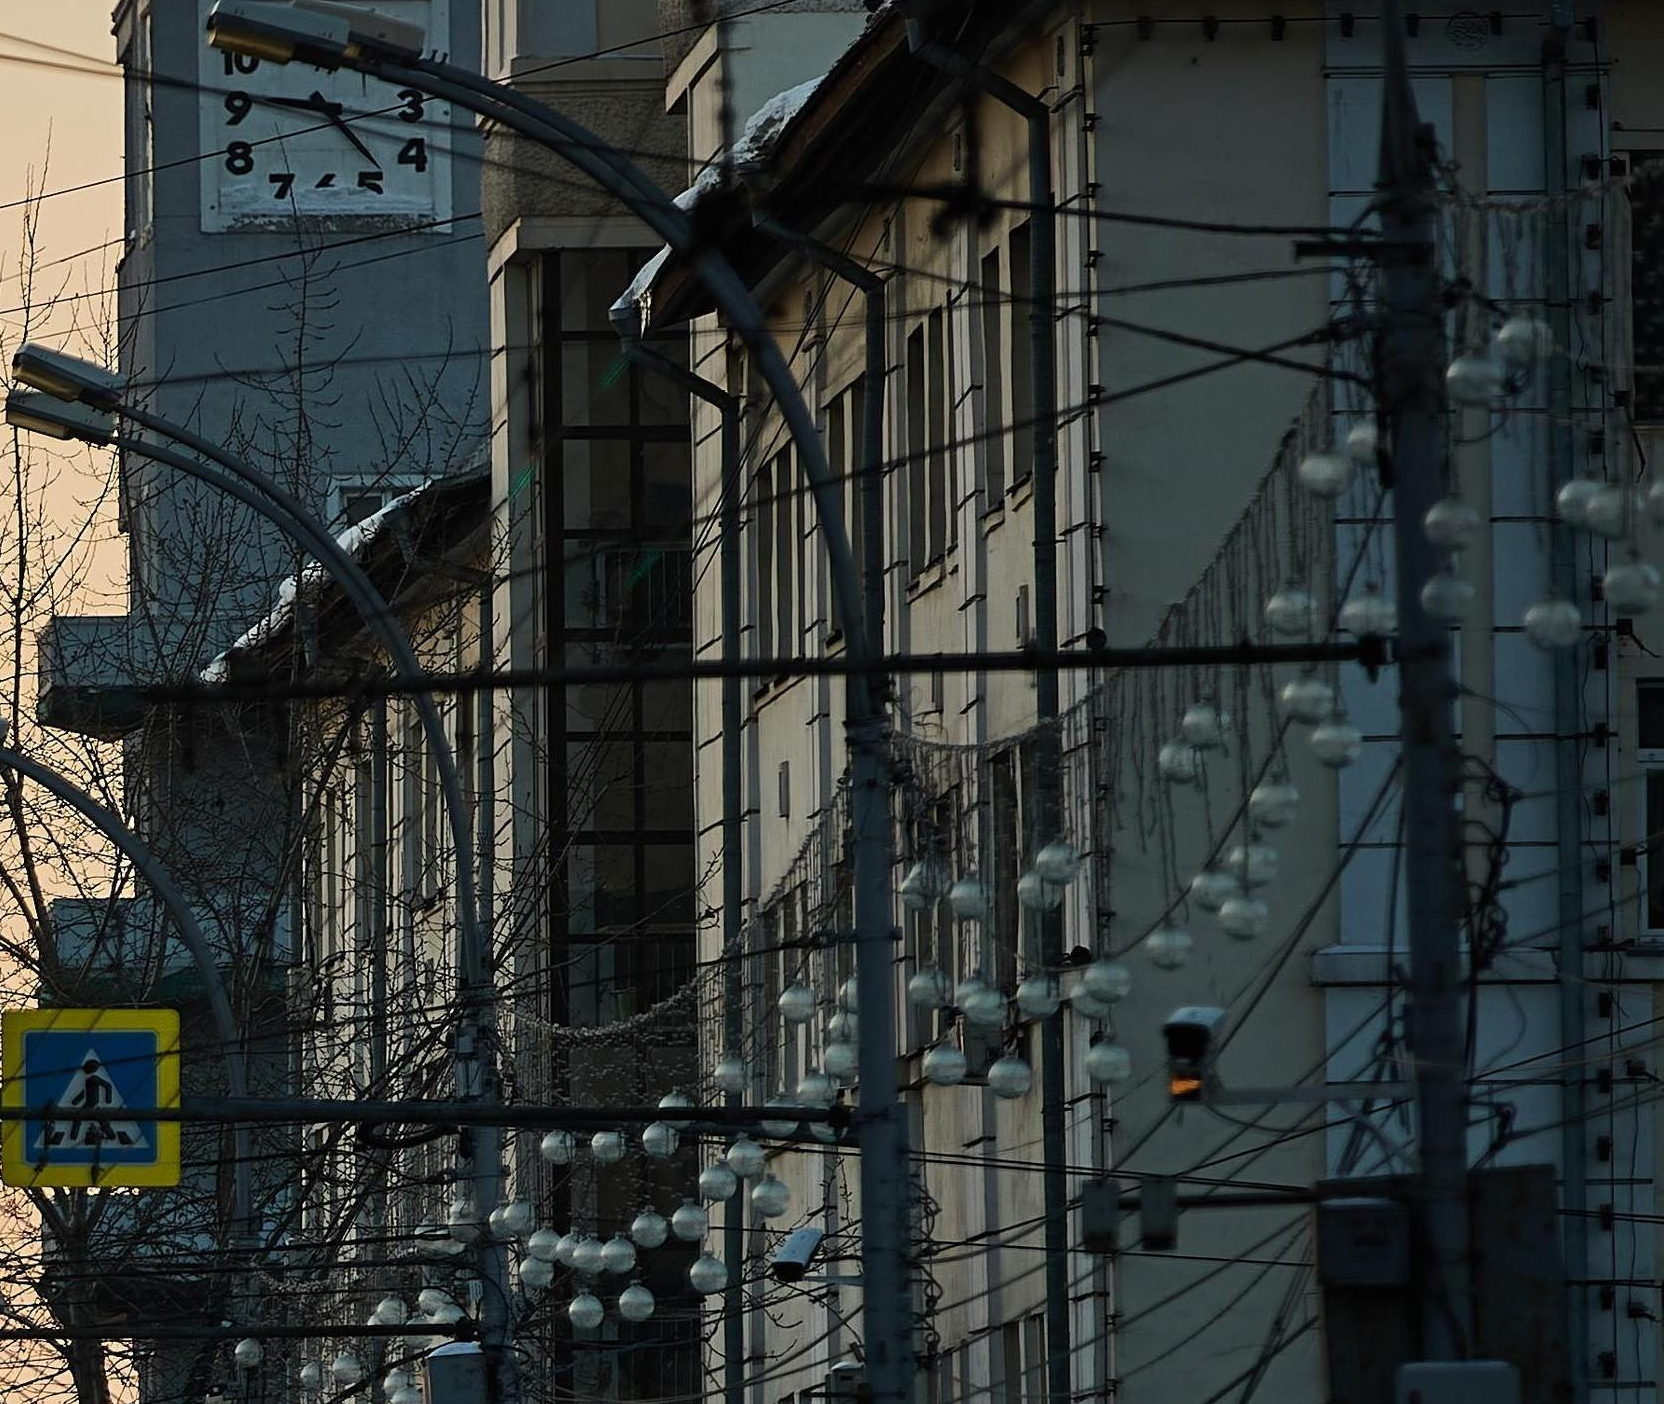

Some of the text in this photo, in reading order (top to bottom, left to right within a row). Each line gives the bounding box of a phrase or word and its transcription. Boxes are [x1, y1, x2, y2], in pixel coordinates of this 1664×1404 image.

[224, 51, 260, 75] 10
[224, 91, 253, 125] 9
[397, 89, 425, 123] 3
[225, 142, 255, 175] 8
[398, 138, 428, 172] 4
[269, 174, 295, 199] 7
